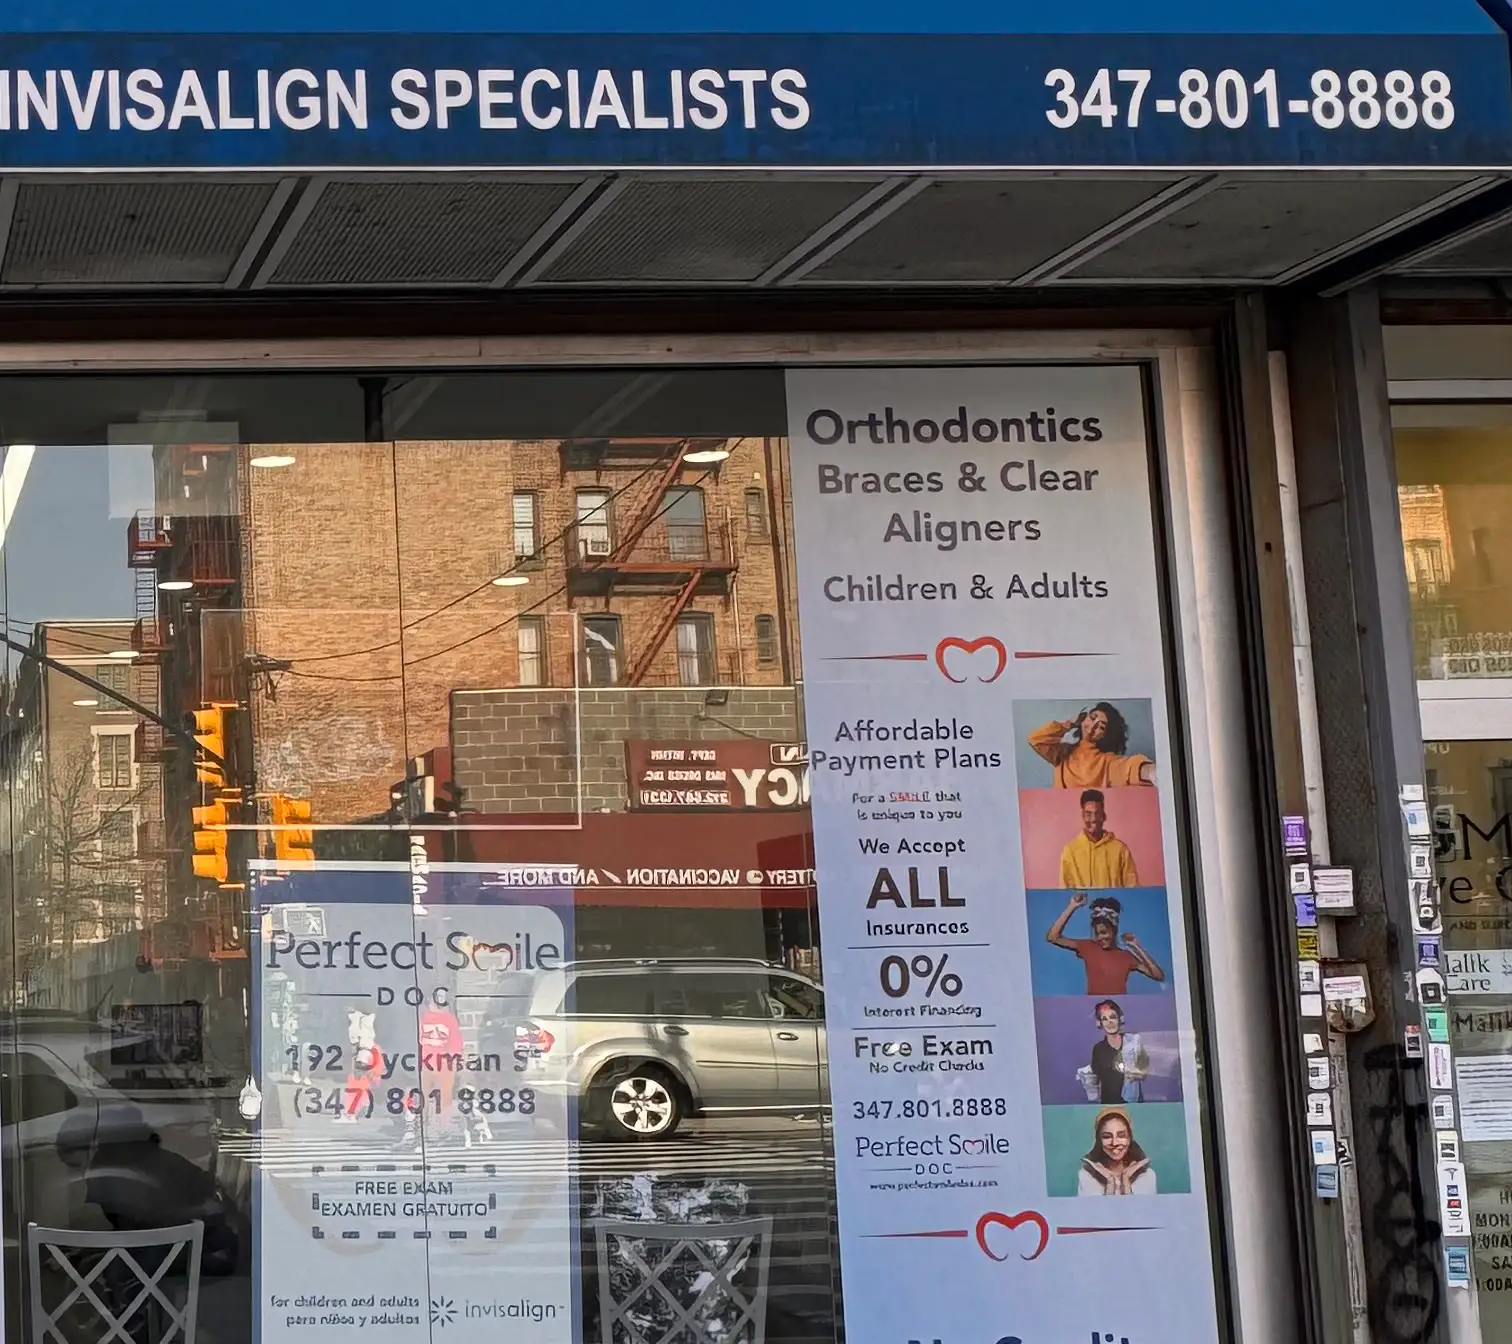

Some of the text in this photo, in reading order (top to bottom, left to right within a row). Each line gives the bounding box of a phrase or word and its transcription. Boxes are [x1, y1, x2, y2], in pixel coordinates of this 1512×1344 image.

[389, 68, 811, 131] SPECIALISTS
[1043, 68, 1456, 130] 347-801-8888
[805, 406, 1103, 445] Orthodontics
[817, 459, 1100, 495] Braces & Clear
[883, 510, 1042, 552] Aligners
[823, 572, 1109, 603] Children & Adults
[834, 718, 975, 743] Affordable
[811, 746, 1002, 777] Payment Plans
[858, 838, 966, 857] We Accept
[865, 866, 967, 910] ALL
[866, 919, 970, 937] Insurances
[266, 929, 434, 970] Perfect
[879, 953, 963, 998] 0%
[377, 987, 450, 1007] DOC
[286, 1044, 344, 1072] 192
[854, 1035, 994, 1058] Free Exam
[869, 1061, 889, 1073] No
[892, 1060, 935, 1073] Credit
[294, 1087, 536, 1118] (347) 801 8888
[852, 1097, 1008, 1121] 347.801.8888
[855, 1135, 944, 1158] Perfect
[354, 1181, 454, 1195] FREE EXAM
[321, 1202, 488, 1218] EXAMEN GRATUITO
[465, 1300, 556, 1323] invisalign
